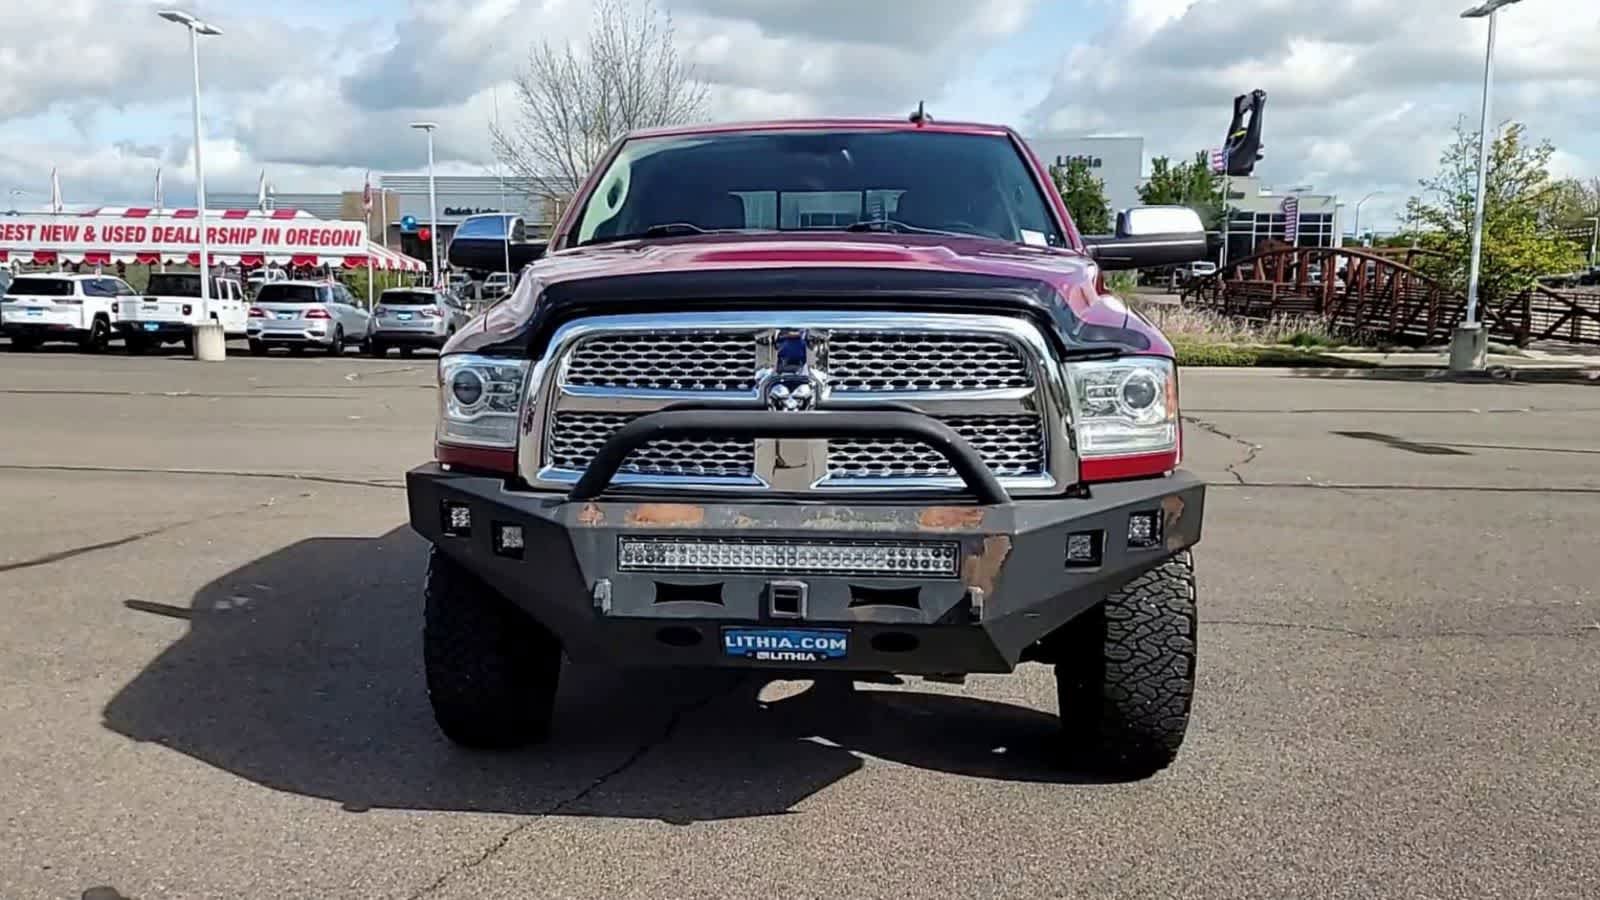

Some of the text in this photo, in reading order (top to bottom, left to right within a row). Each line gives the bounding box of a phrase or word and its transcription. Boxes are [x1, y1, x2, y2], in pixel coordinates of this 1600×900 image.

[1056, 155, 1103, 168] Liia
[39, 224, 79, 243] NEW
[83, 226, 97, 242] &
[102, 225, 147, 243] USED
[261, 227, 281, 246] IN
[285, 228, 362, 248] OREGON!
[725, 635, 847, 650] LITHIA.COM
[770, 651, 817, 662] LITHIA
